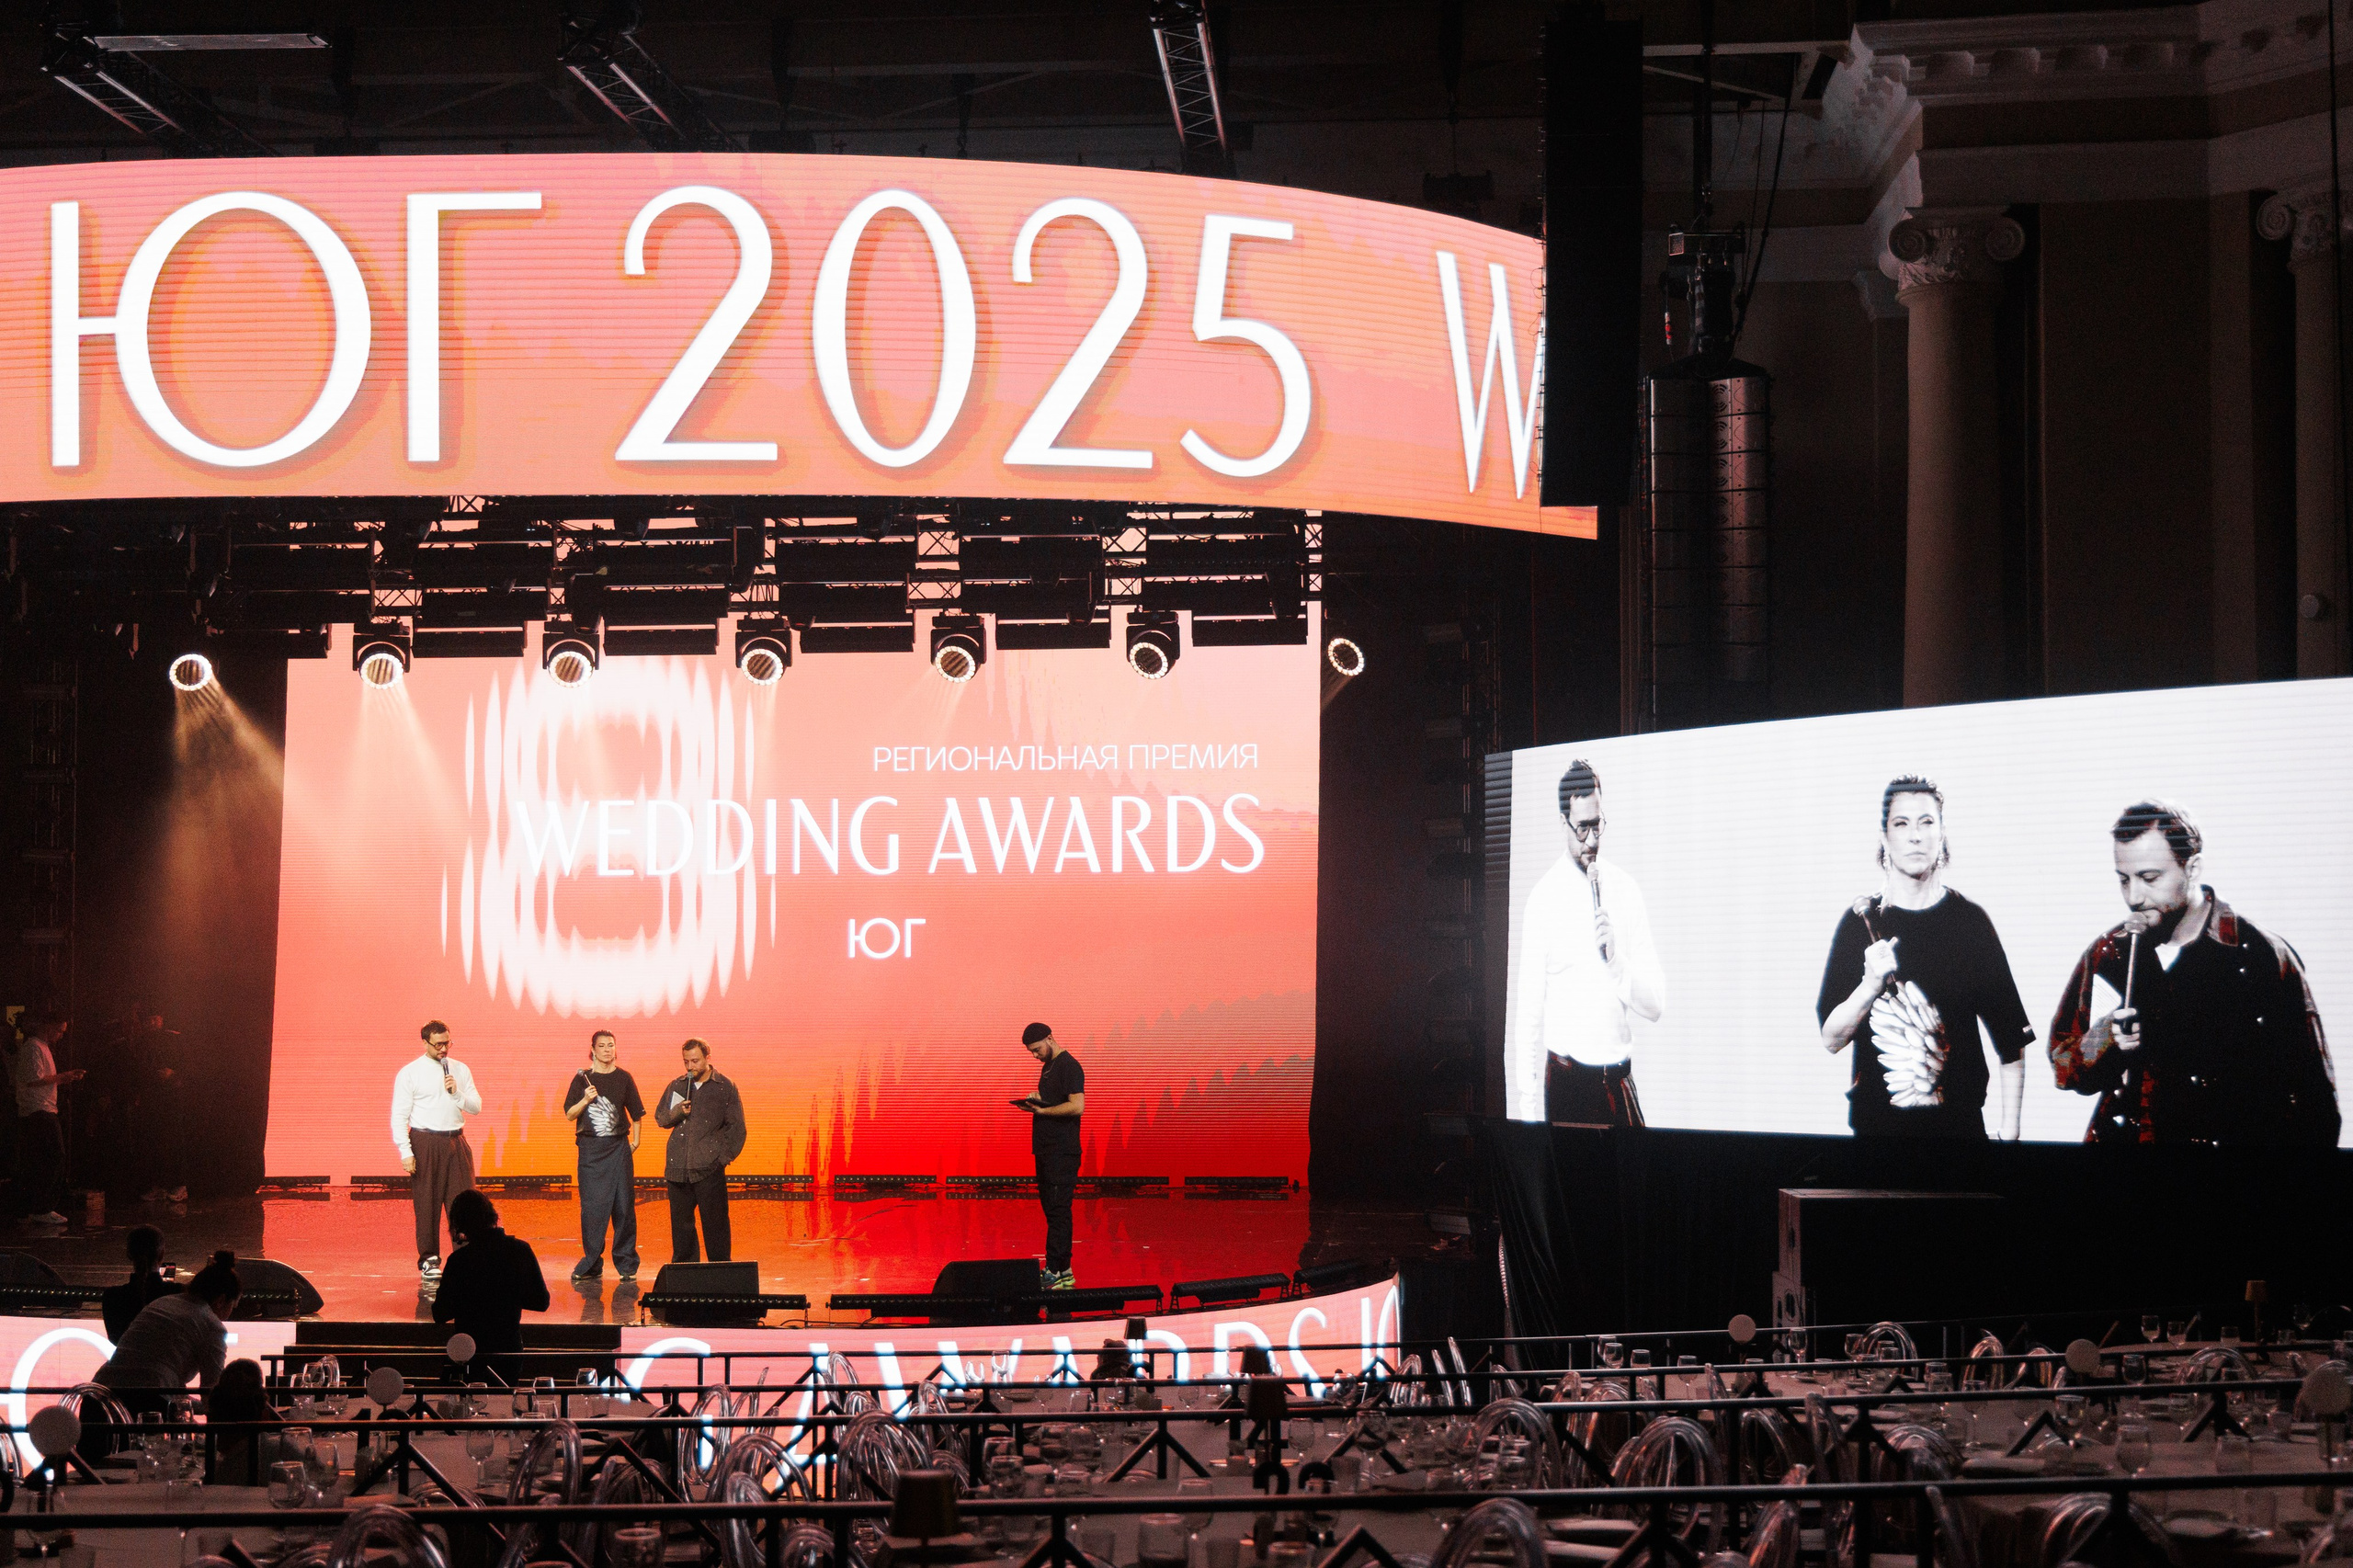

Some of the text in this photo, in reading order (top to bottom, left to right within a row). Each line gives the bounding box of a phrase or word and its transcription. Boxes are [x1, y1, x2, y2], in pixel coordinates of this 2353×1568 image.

[51, 191, 542, 467] ЮГ
[615, 185, 1312, 478] 2025
[873, 743, 1259, 772] РЕГИОНАЛЬНАЯ ПРЕМИЯ
[516, 792, 1265, 877] WEDDING AWARDS
[847, 917, 927, 959] ЮГ
